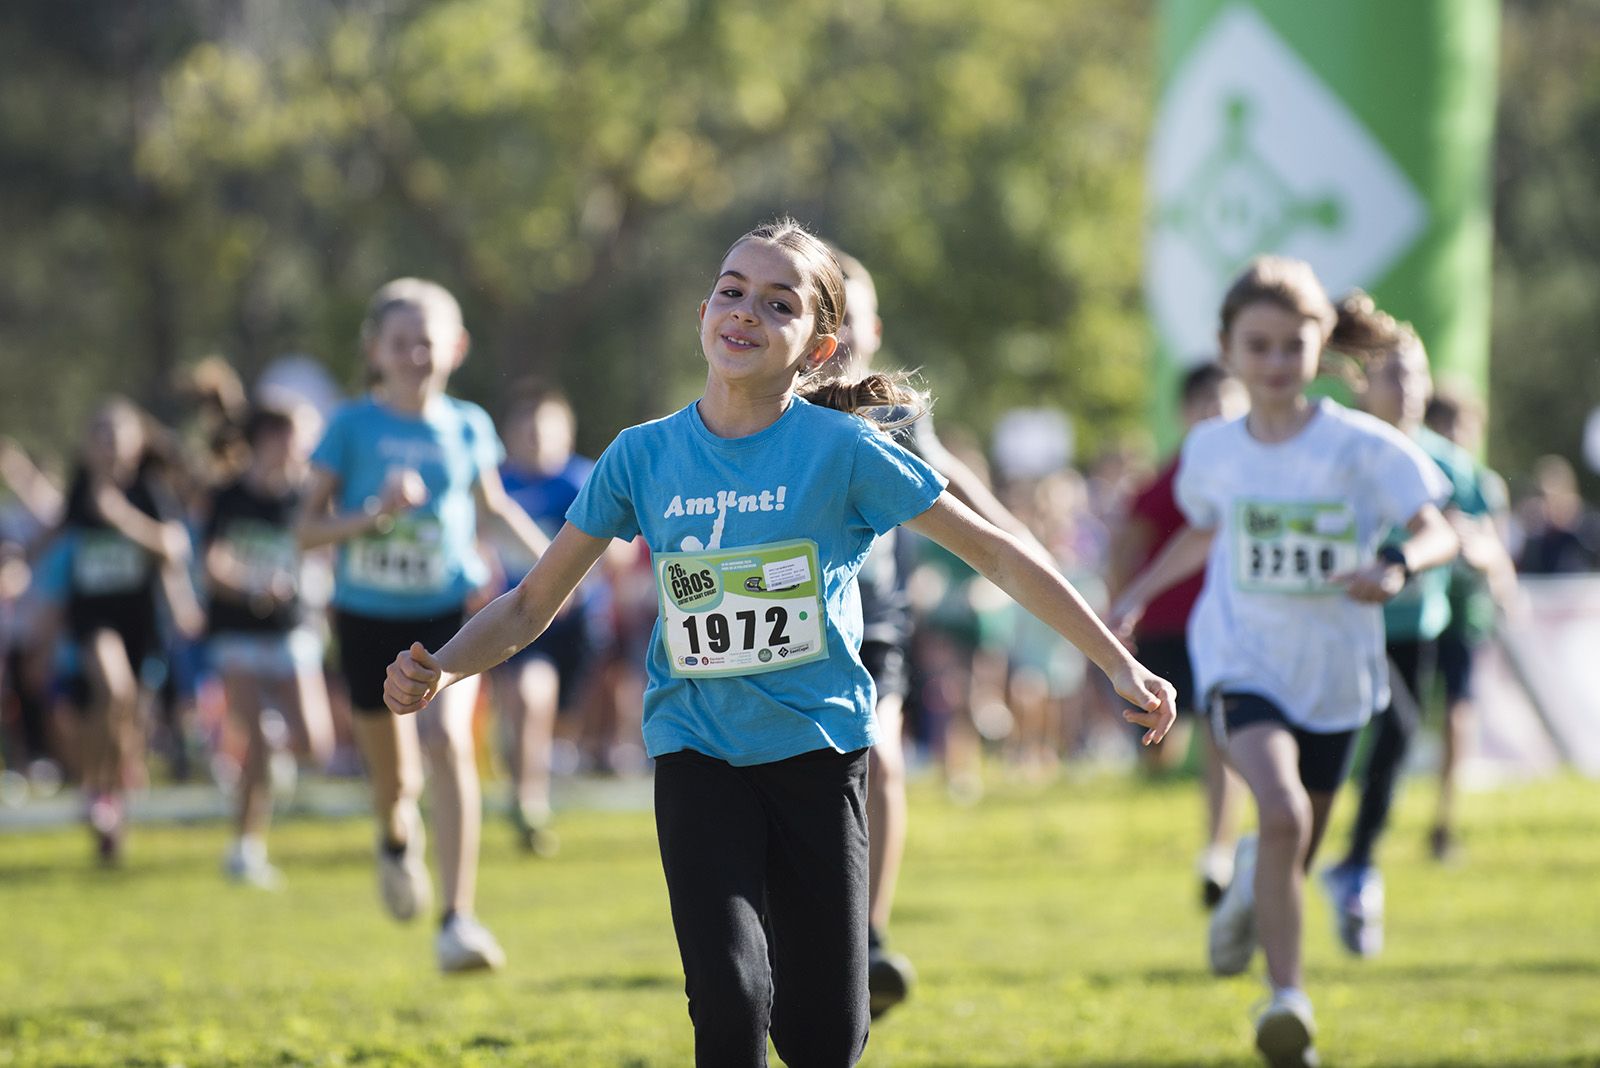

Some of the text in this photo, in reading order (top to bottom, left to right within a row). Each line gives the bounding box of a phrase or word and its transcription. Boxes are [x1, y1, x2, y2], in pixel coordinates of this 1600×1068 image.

[664, 486, 787, 519] Amunt!
[672, 569, 715, 599] CROS
[682, 606, 790, 654] 1972
